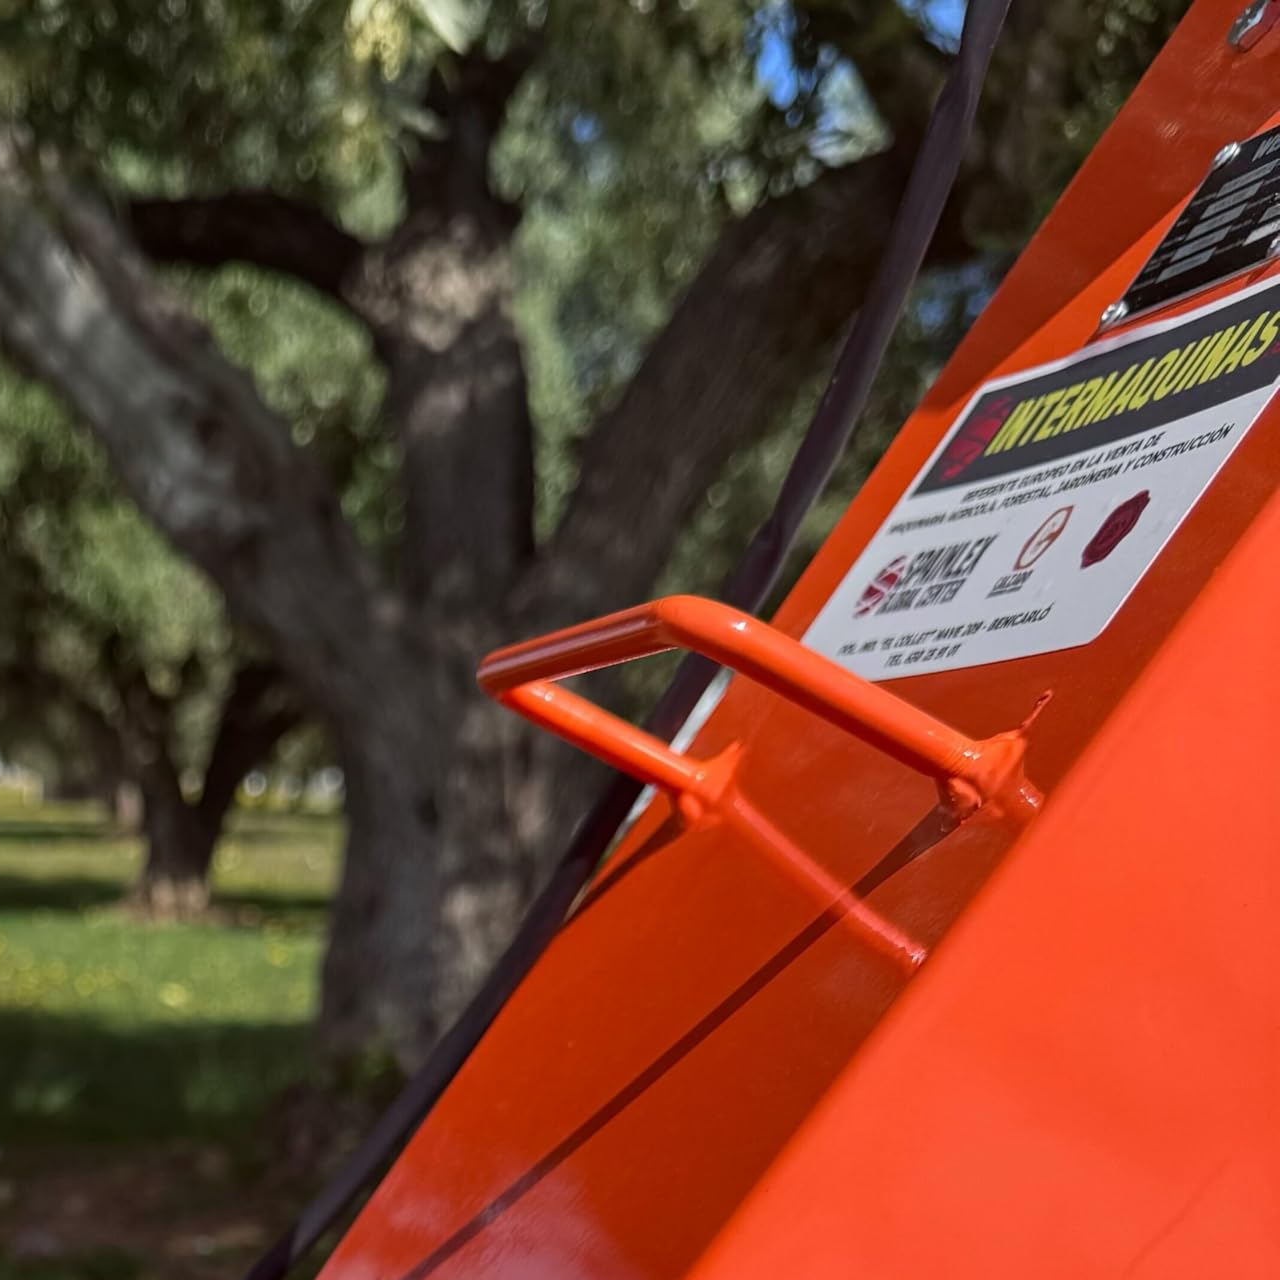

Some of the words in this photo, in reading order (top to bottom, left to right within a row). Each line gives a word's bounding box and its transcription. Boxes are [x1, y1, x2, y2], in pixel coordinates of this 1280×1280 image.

[983, 310, 1280, 457] INTERMAQUINAS
[1104, 439, 1144, 463] VENTA
[1143, 431, 1167, 450] DE
[1122, 459, 1137, 473] Y
[1132, 423, 1236, 471] CONSTRUCCIÓN
